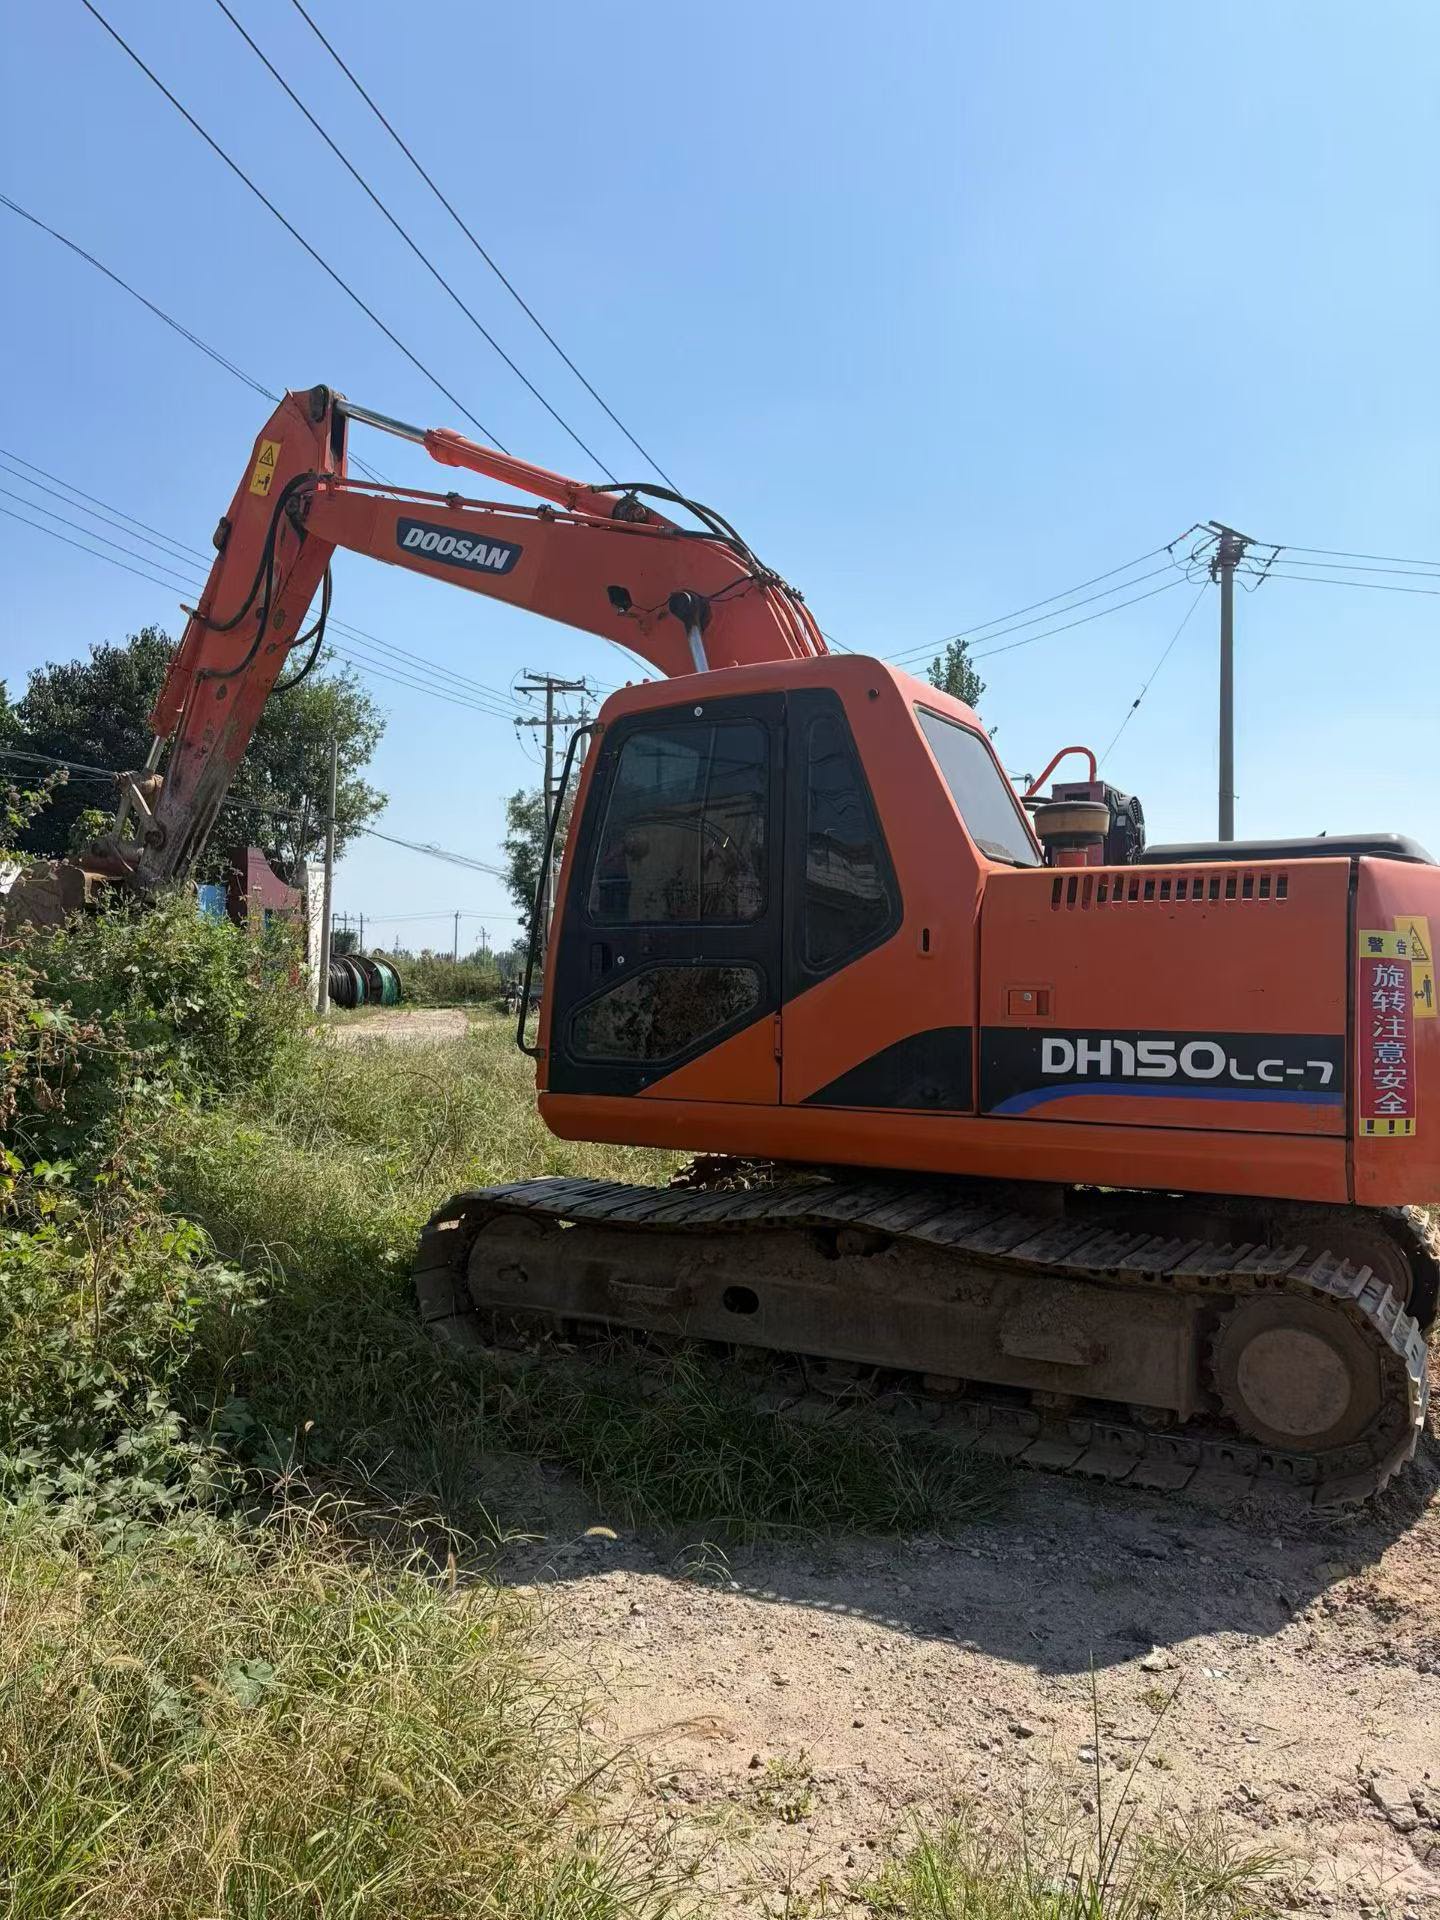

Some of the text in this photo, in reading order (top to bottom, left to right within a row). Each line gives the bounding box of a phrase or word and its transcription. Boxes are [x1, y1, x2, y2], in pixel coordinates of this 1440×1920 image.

[403, 527, 511, 570] DOOSAN
[1367, 936, 1407, 955] 警告
[1372, 964, 1407, 1115] 旋转注意安全
